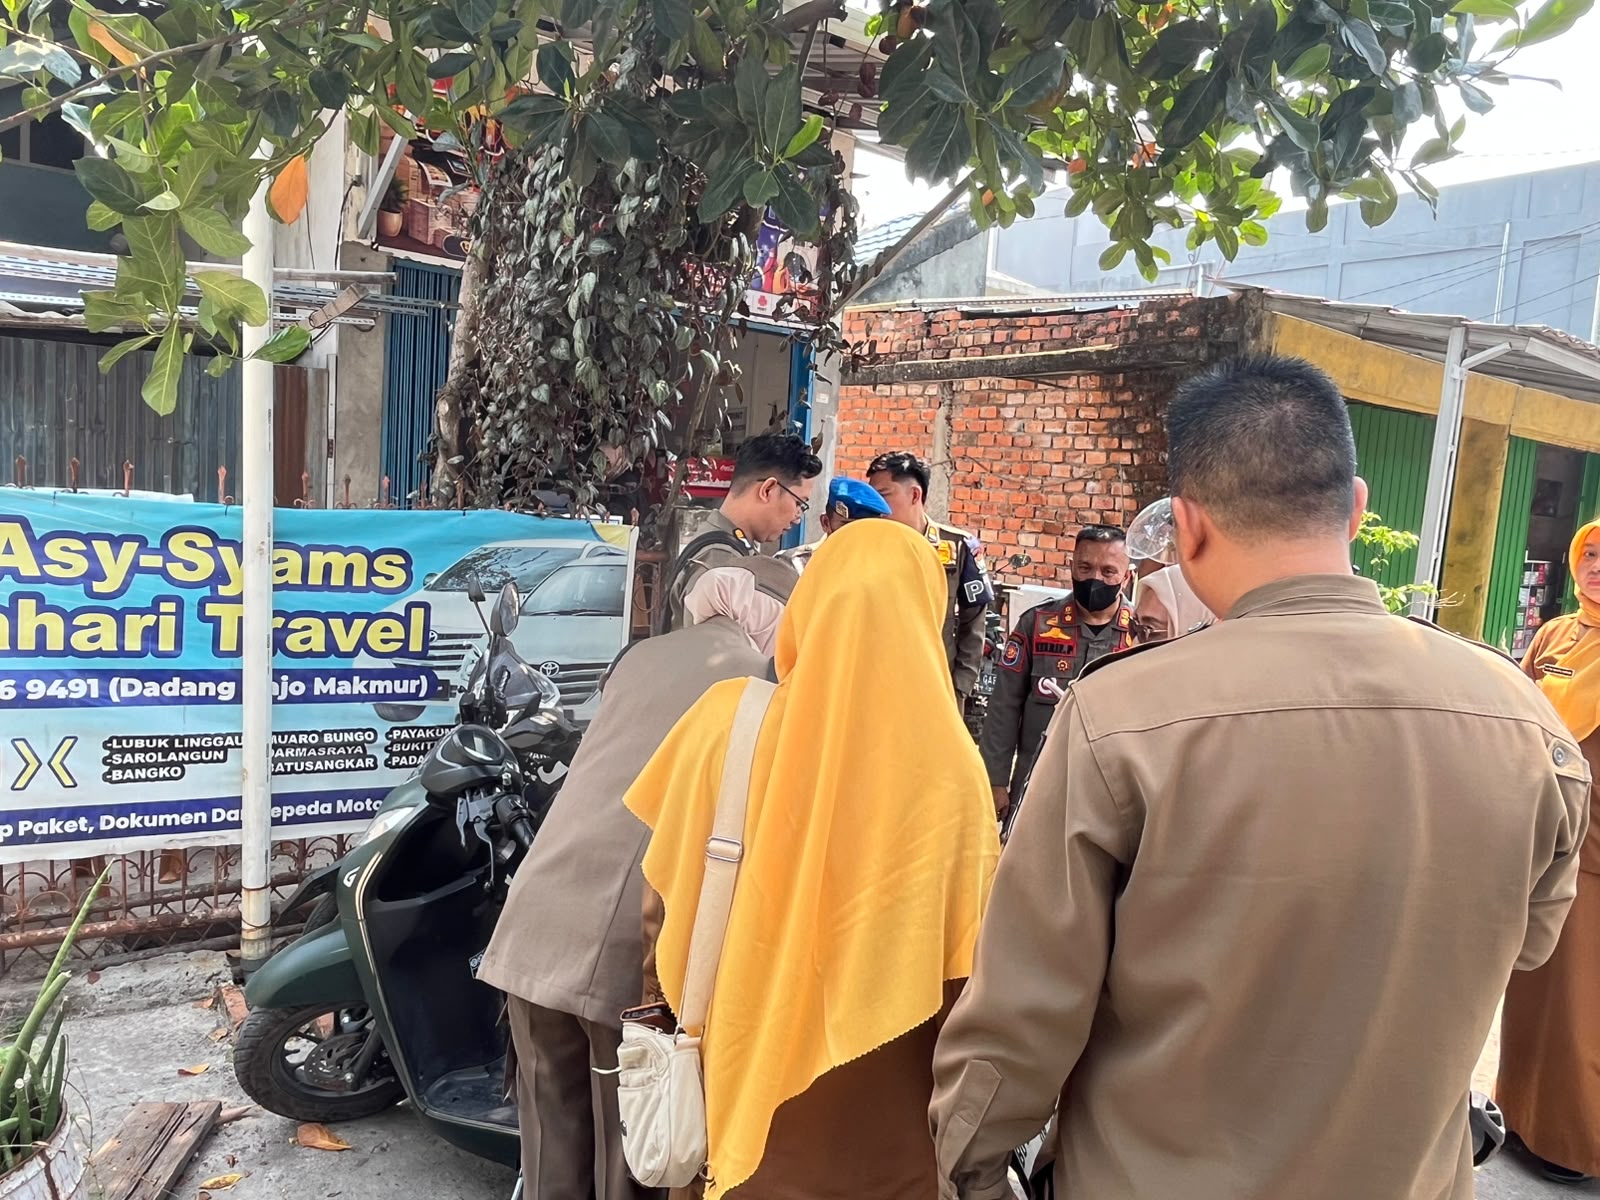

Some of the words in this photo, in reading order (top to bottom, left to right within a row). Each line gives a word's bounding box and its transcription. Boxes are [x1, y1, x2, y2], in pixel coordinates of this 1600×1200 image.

[0, 599, 176, 651] hari
[26, 678, 99, 699] 9491
[109, 677, 236, 702] (Dadang
[272, 675, 306, 701] jo
[313, 675, 428, 697] Makmur)
[106, 738, 169, 749] -LUBUK
[323, 731, 375, 743] BUNGO
[271, 745, 363, 758] ARMASRAYA
[387, 741, 437, 752] -BUKIT
[106, 750, 224, 765] -SAROLANGUN
[271, 757, 374, 773] ATUSANGKAR
[106, 766, 182, 781] -BANGKO
[18, 816, 95, 837] Paket,
[100, 809, 207, 831] Dokumen
[212, 807, 243, 823] Da
[271, 801, 332, 822] epeda
